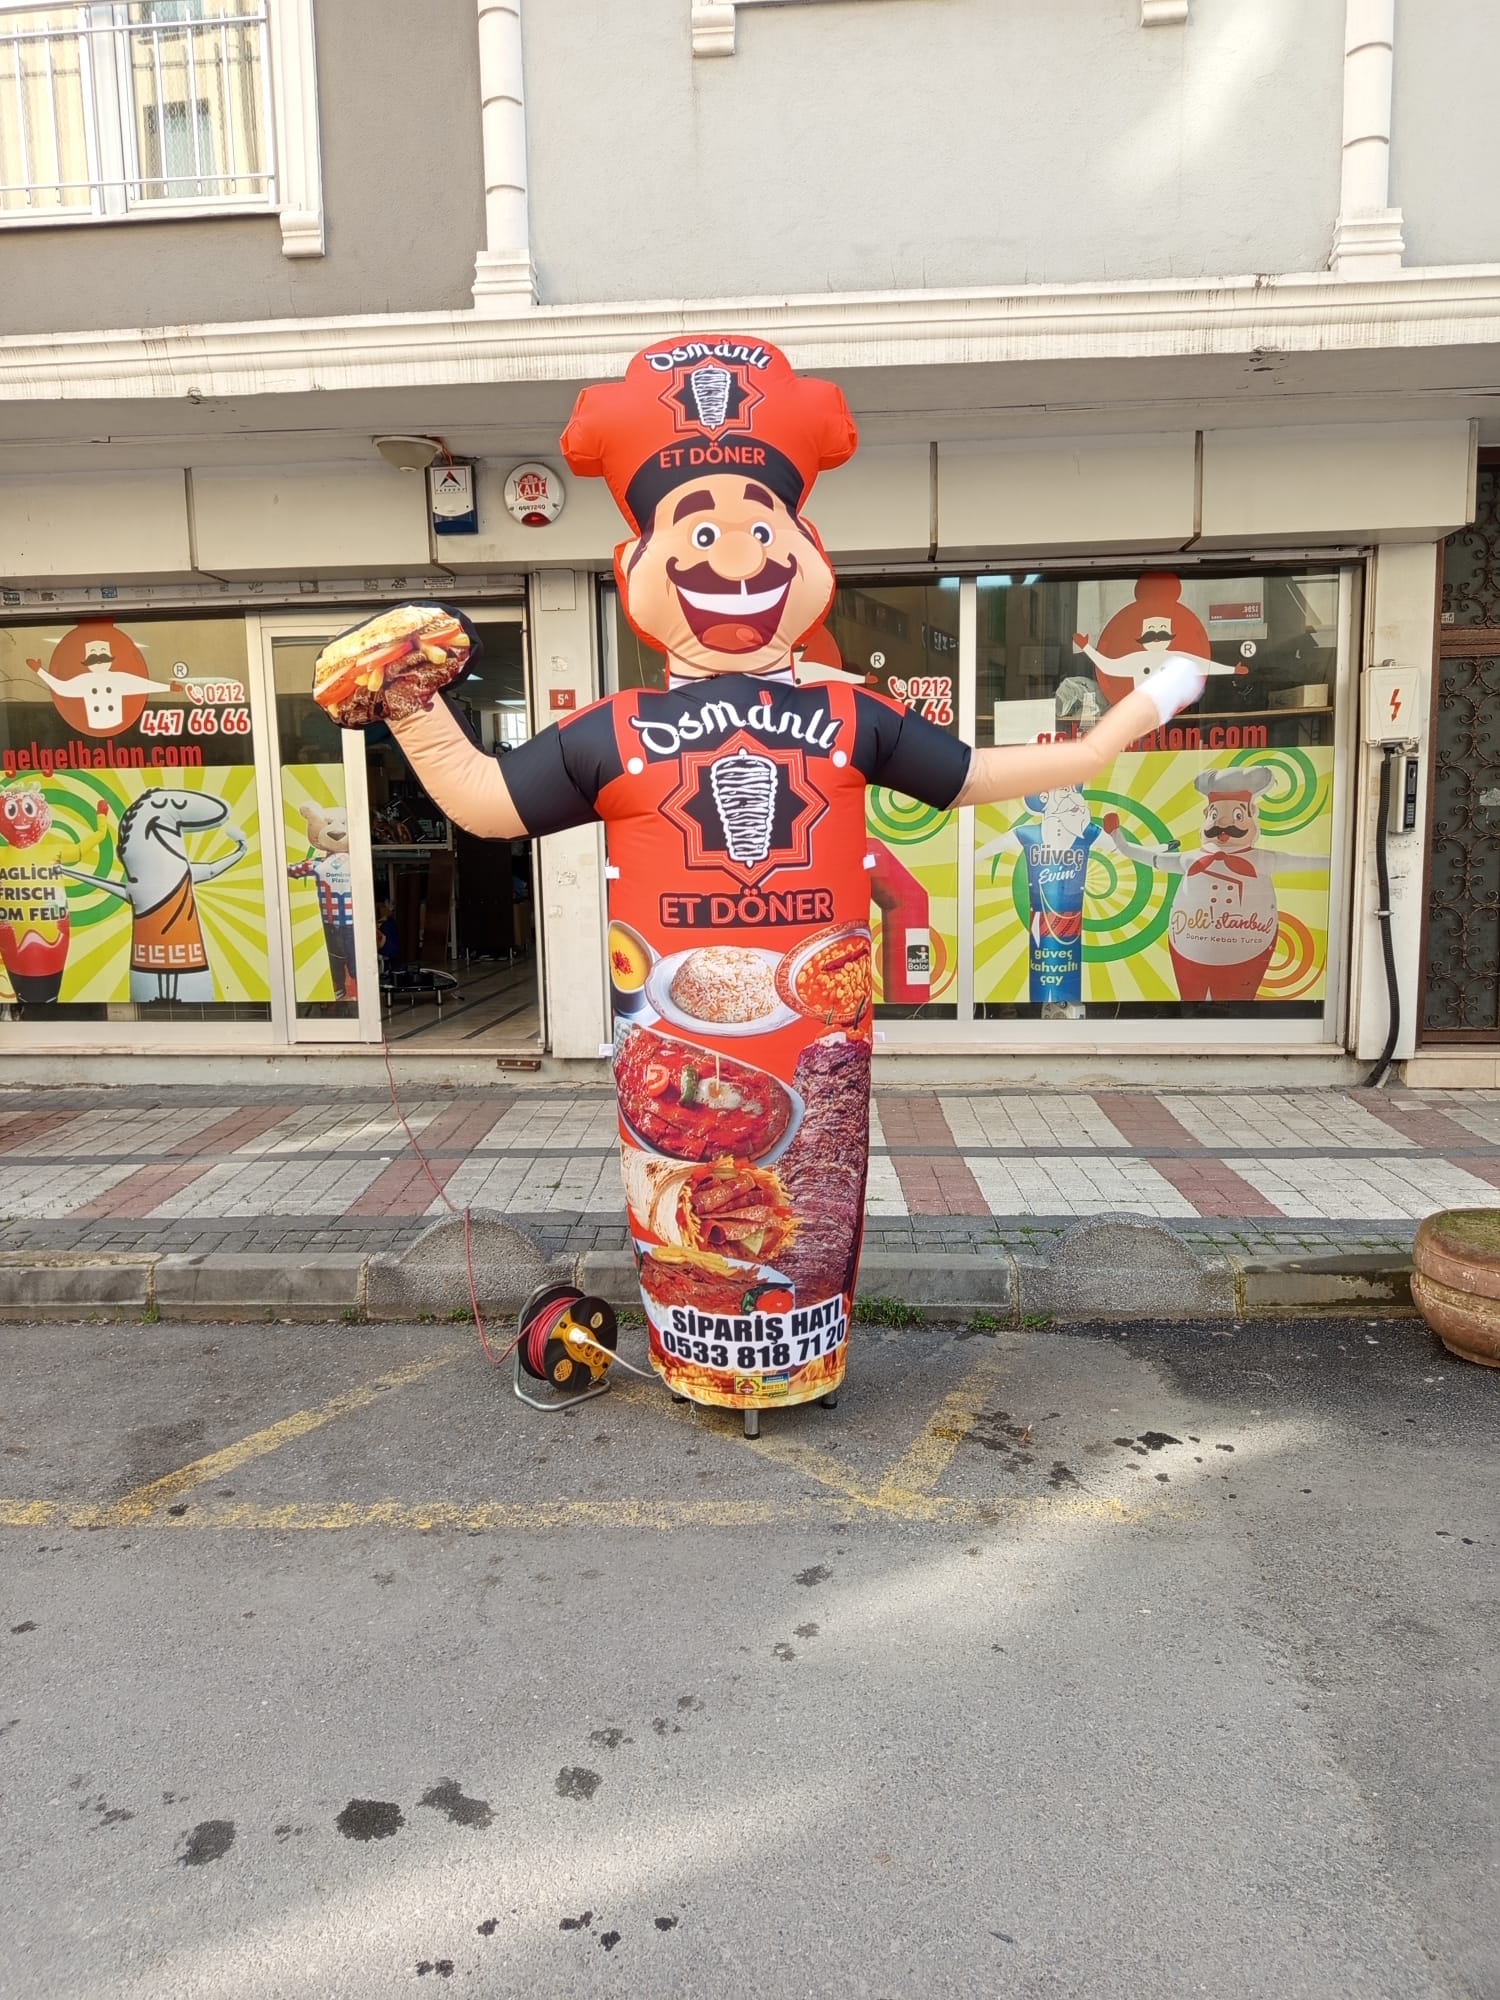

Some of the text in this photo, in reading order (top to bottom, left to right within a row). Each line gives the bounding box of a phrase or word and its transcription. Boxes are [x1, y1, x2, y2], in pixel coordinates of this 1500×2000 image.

[660, 442, 766, 468] ET DÖNER
[513, 478, 548, 501] KALE
[206, 684, 243, 703] 0212
[909, 678, 950, 698] 0212
[141, 709, 249, 734] 447 66 66
[3, 740, 204, 778] gelgelbalon.com
[1030, 844, 1084, 871] Güveç
[29, 907, 66, 920] FELD
[661, 888, 832, 925] ET DÖNER
[1210, 935, 1238, 943] Kebab
[1034, 949, 1073, 961] güveç
[1040, 975, 1064, 986] çay
[671, 1298, 841, 1344] SİPARİŞ HATI
[663, 1318, 846, 1370] 0533 818 71 20
